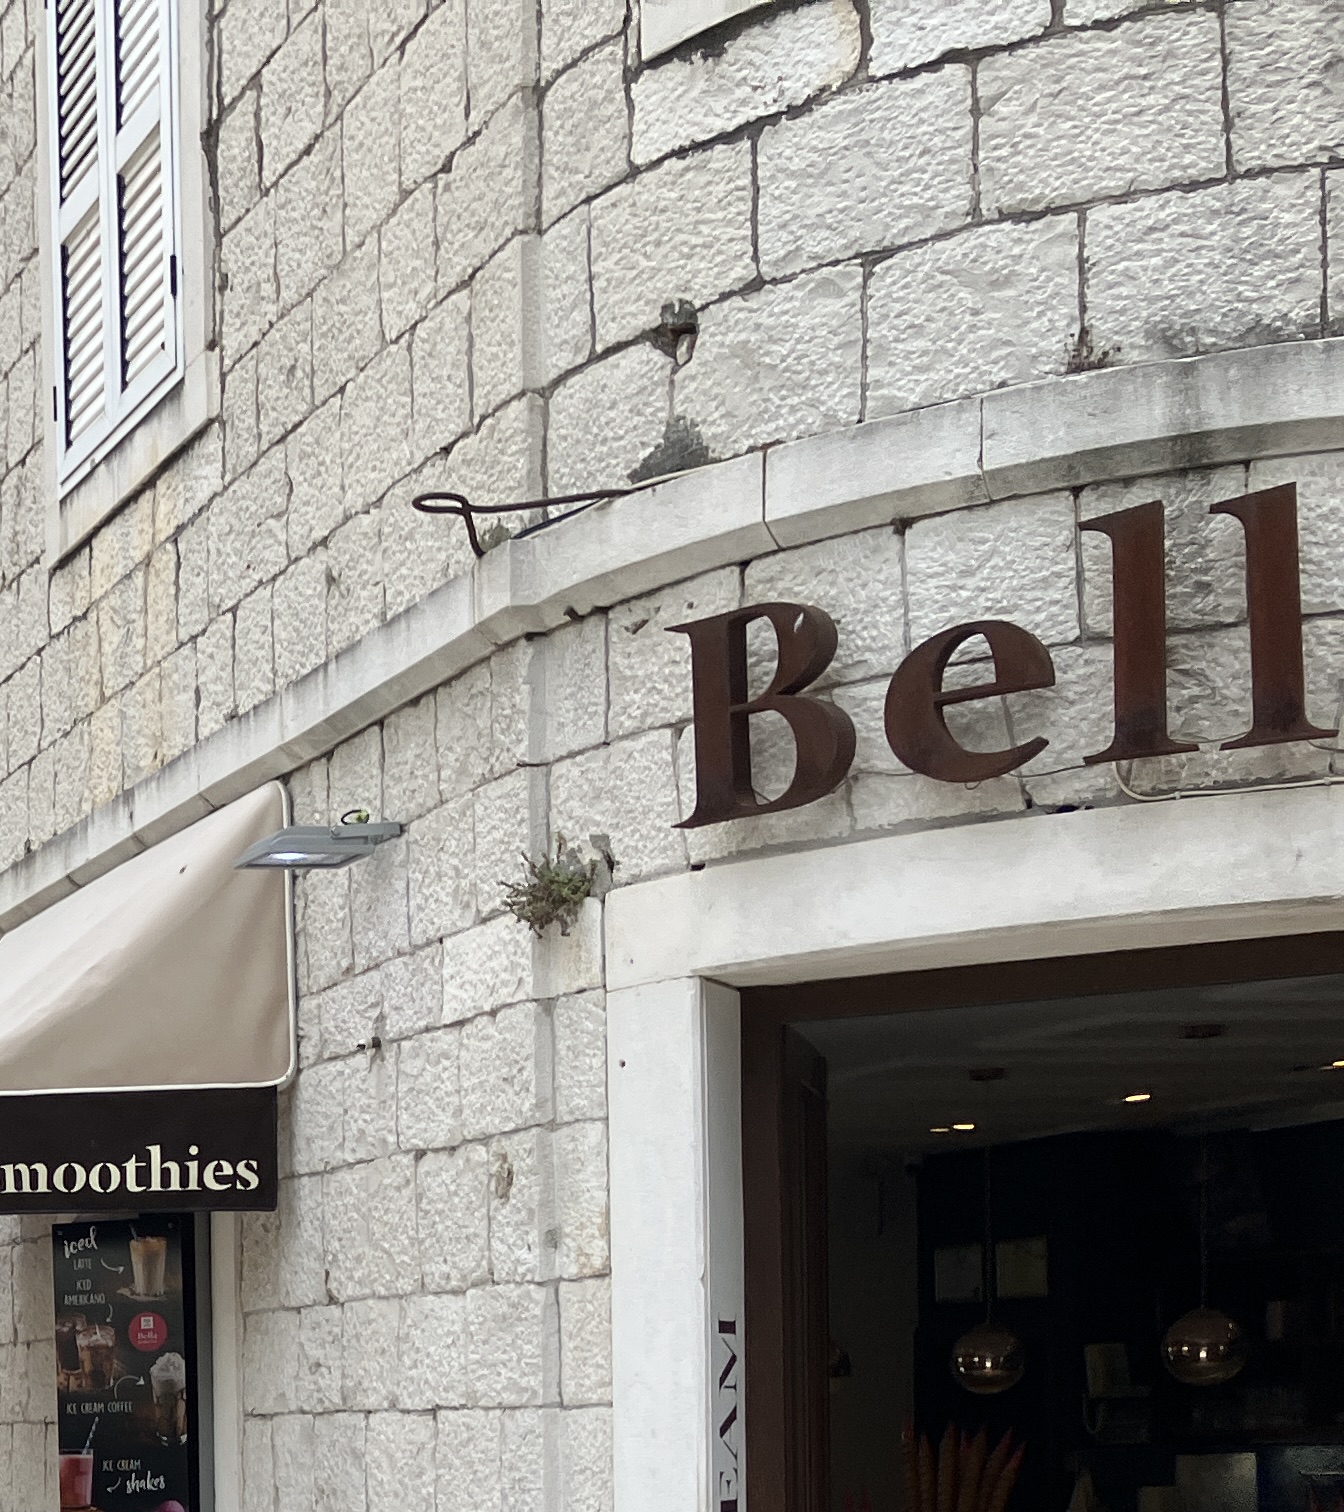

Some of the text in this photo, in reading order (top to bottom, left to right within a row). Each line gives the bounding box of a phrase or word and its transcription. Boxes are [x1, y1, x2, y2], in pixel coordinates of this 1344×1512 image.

[665, 482, 1338, 828] Bell
[64, 1225, 98, 1258] iced
[66, 1401, 133, 1415] ICE CREAM COFFEE
[126, 1470, 166, 1494] shakes
